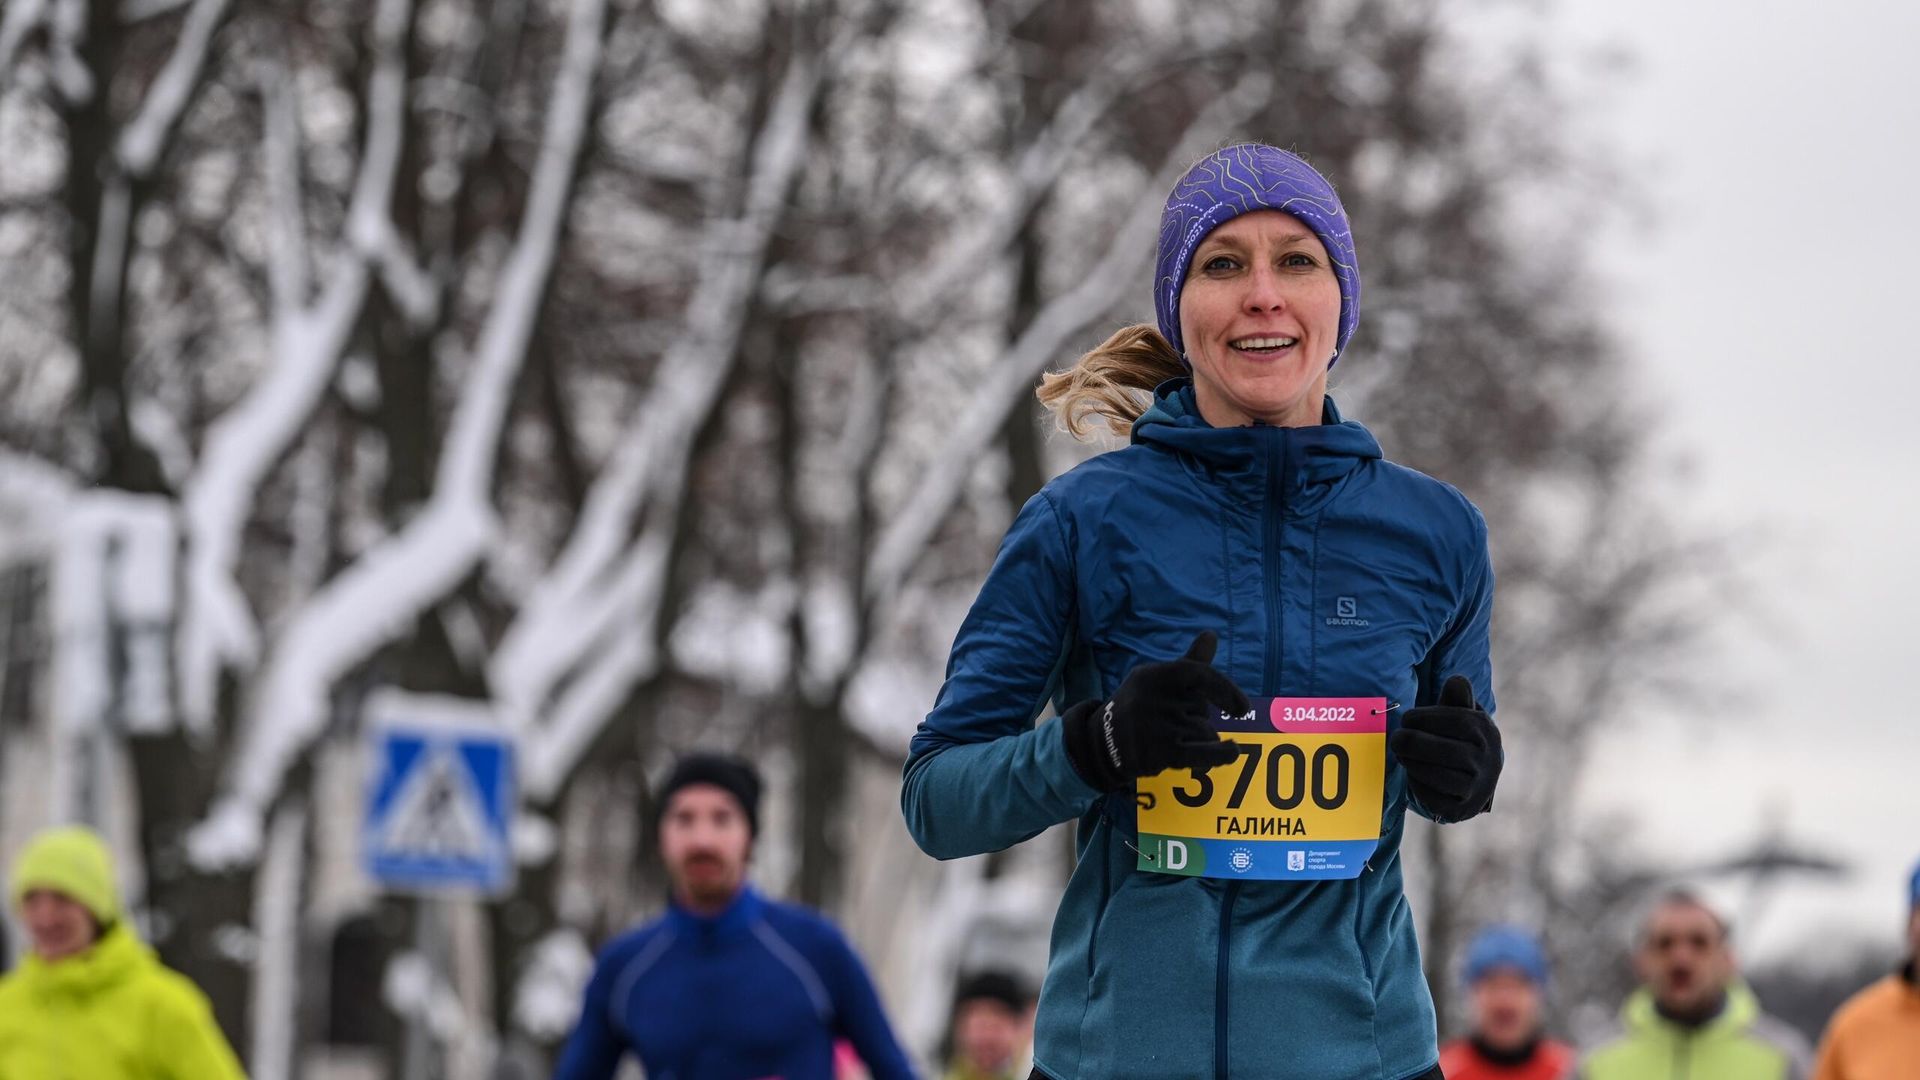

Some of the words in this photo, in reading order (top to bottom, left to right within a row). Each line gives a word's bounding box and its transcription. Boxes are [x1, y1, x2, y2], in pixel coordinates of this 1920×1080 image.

[1282, 707, 1356, 722] 3.04.2022
[1103, 710, 1122, 769] Columbia
[1172, 743, 1350, 811] 3700
[1216, 816, 1307, 836] ГАЛИНА
[1166, 839, 1188, 871] D
